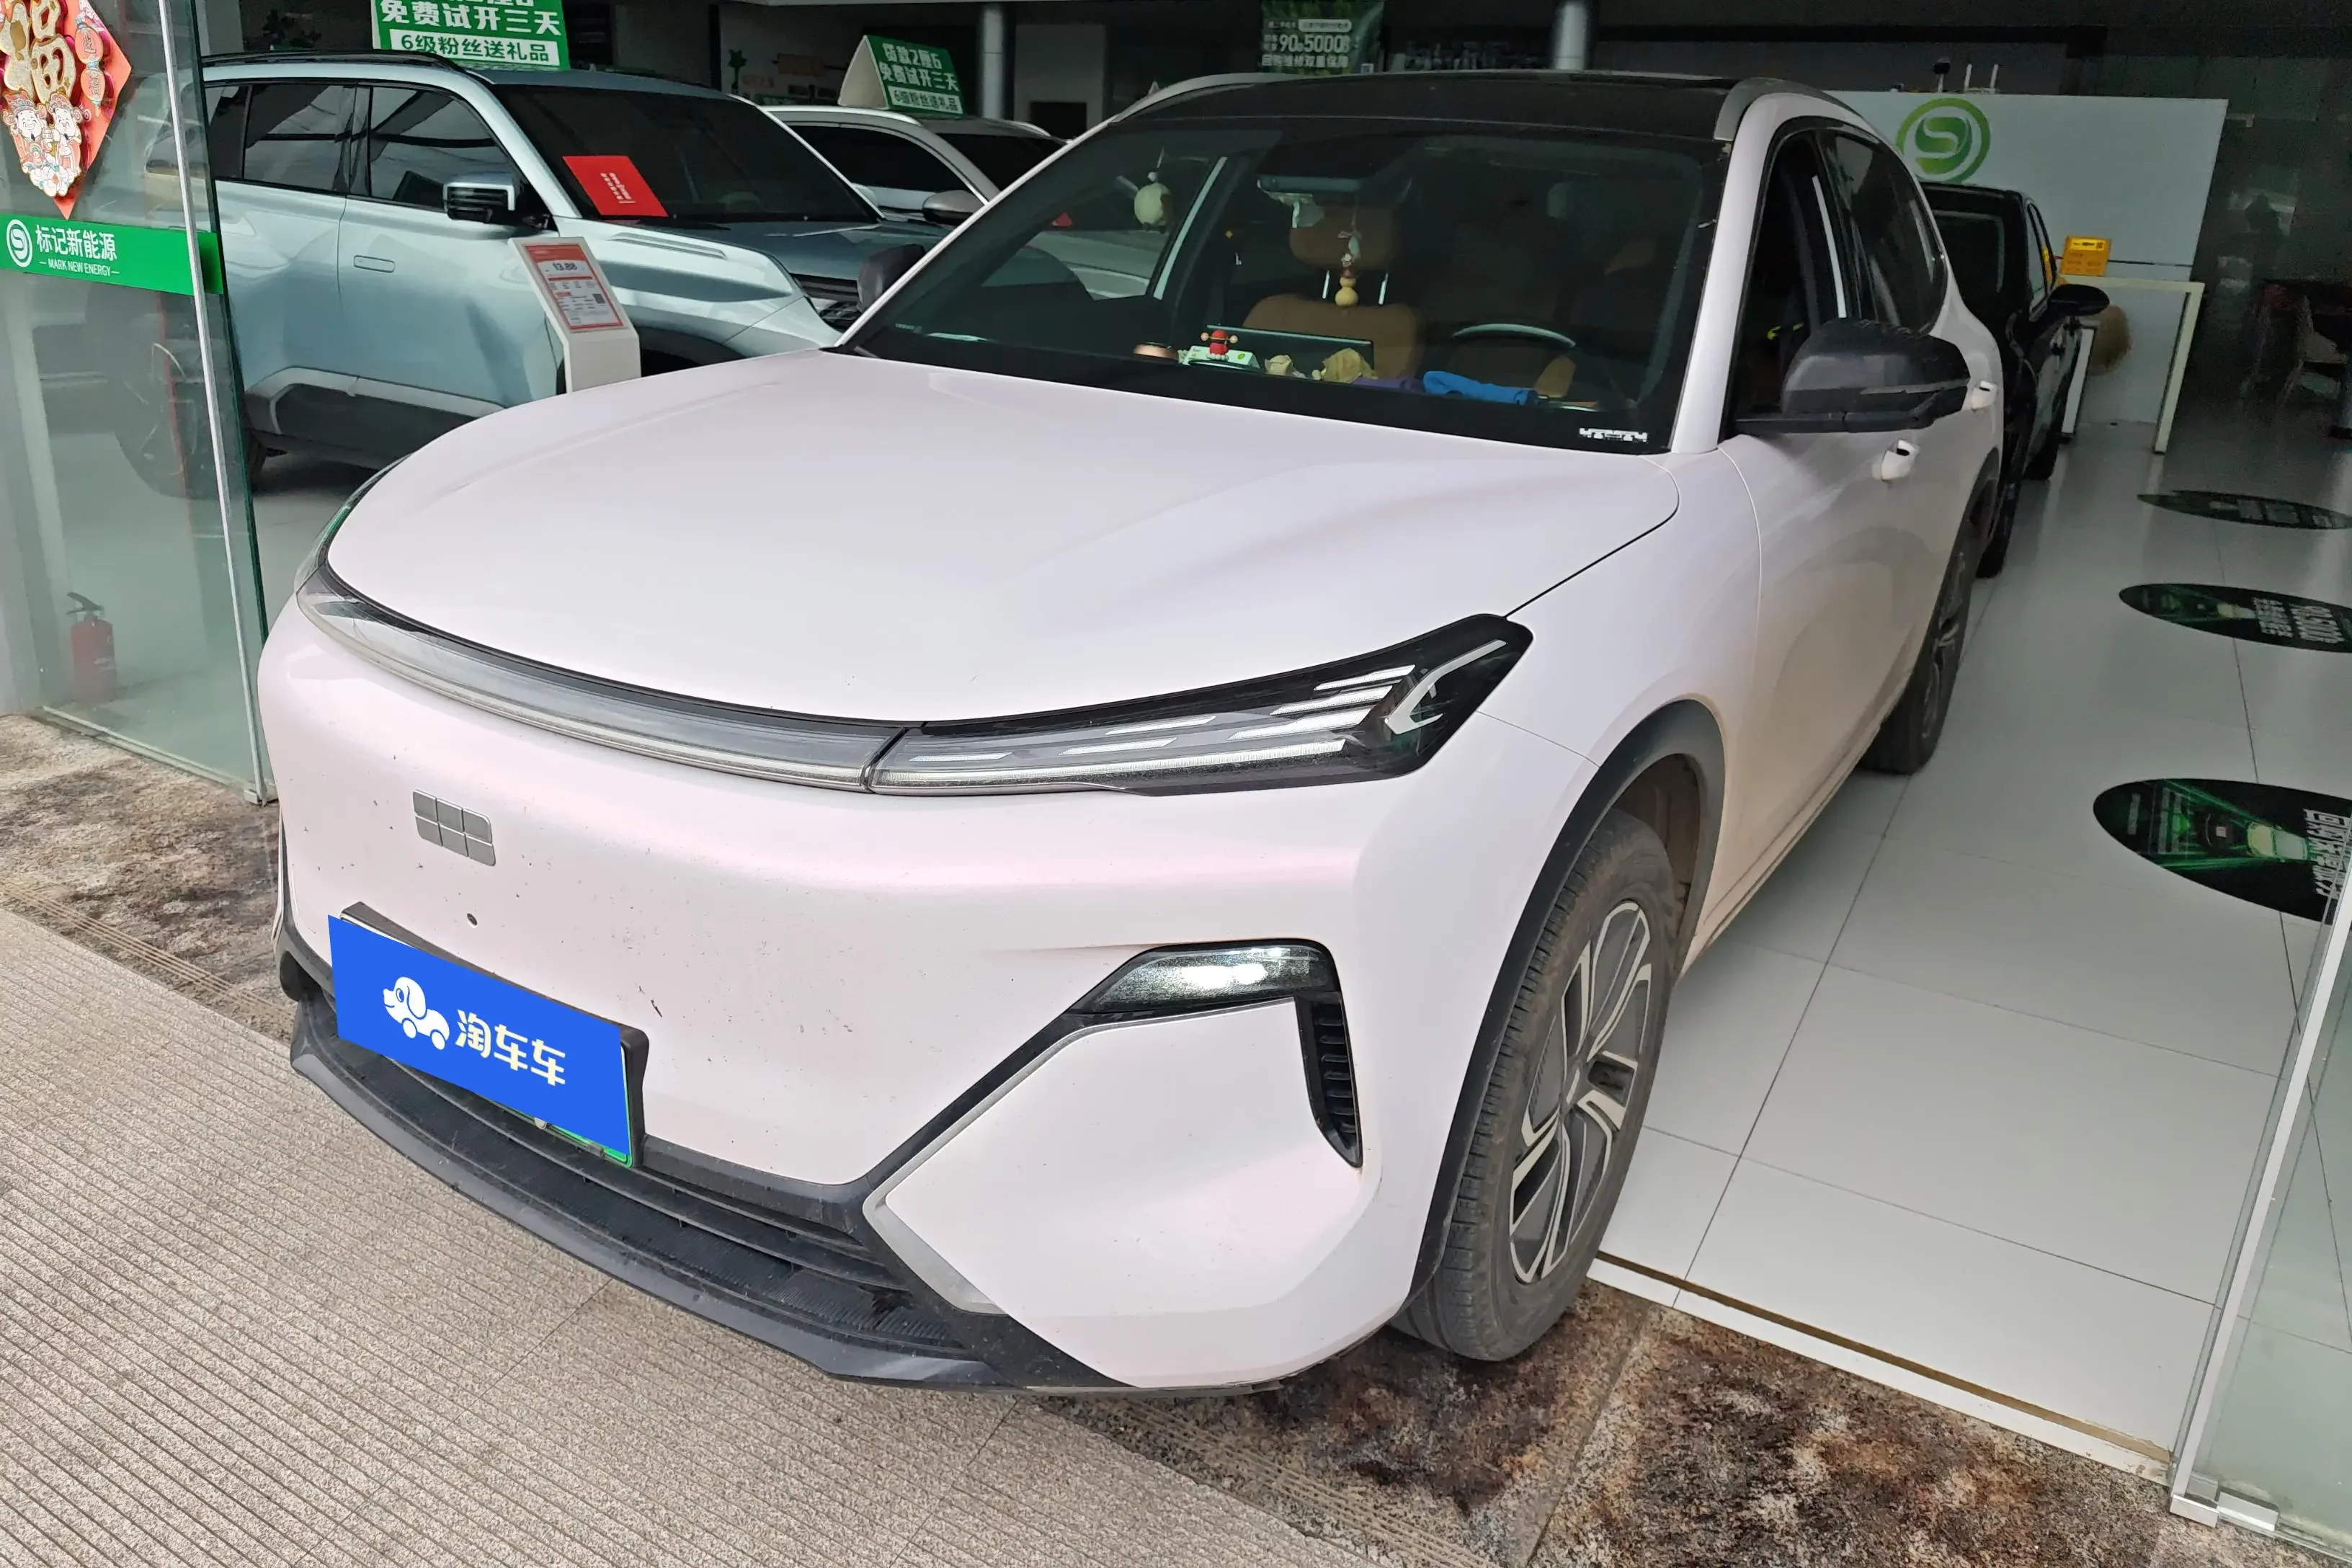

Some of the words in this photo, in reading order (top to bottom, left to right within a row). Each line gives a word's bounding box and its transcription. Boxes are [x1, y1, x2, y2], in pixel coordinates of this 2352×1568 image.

[381, 1, 562, 35] 免费试开三天
[401, 35, 549, 62] 6级粉丝送礼品
[35, 224, 117, 262] 标记新能源
[48, 258, 67, 270] MARK
[67, 261, 83, 273] NEW
[84, 263, 110, 277] ENERGY
